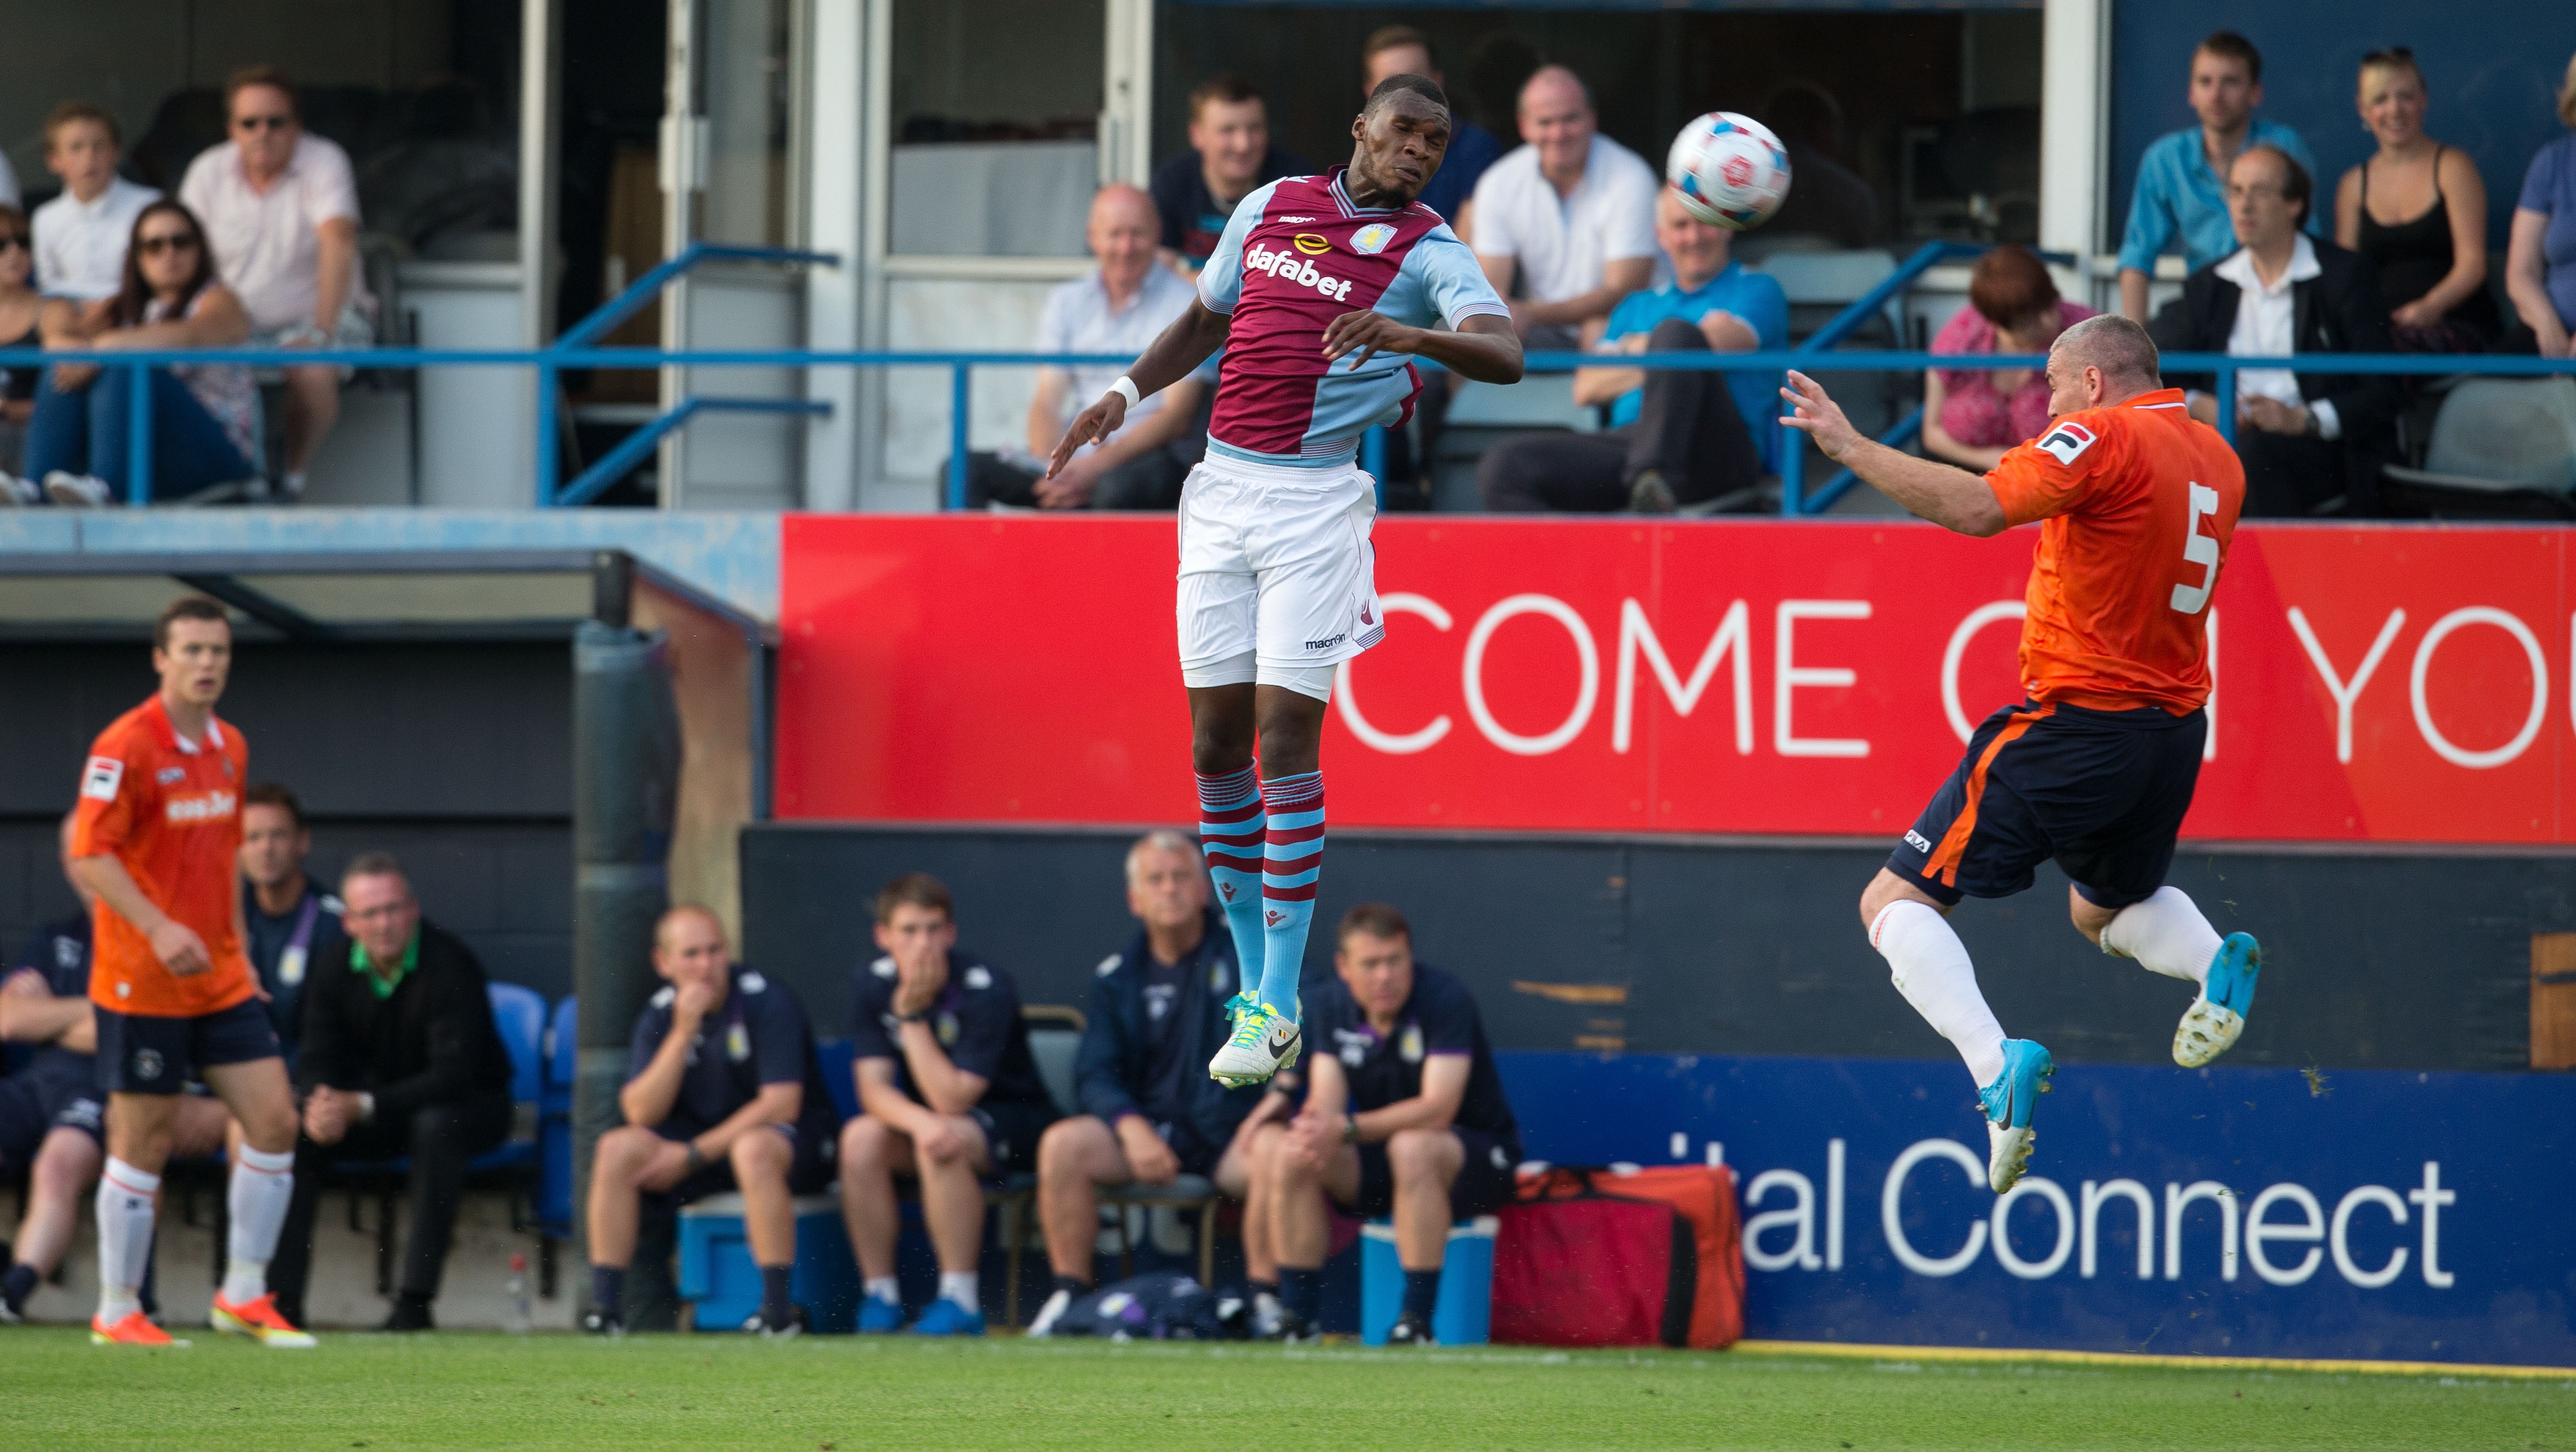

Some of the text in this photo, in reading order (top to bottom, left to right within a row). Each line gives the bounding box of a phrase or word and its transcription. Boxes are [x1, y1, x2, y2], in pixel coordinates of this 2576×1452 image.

[1246, 243, 1352, 302] dafabet
[2170, 481, 2220, 615] 5
[1306, 633, 1346, 650] macron
[1333, 592, 1873, 757] COME
[2286, 605, 2576, 768] YO
[1881, 1137, 2456, 1289] Connect
